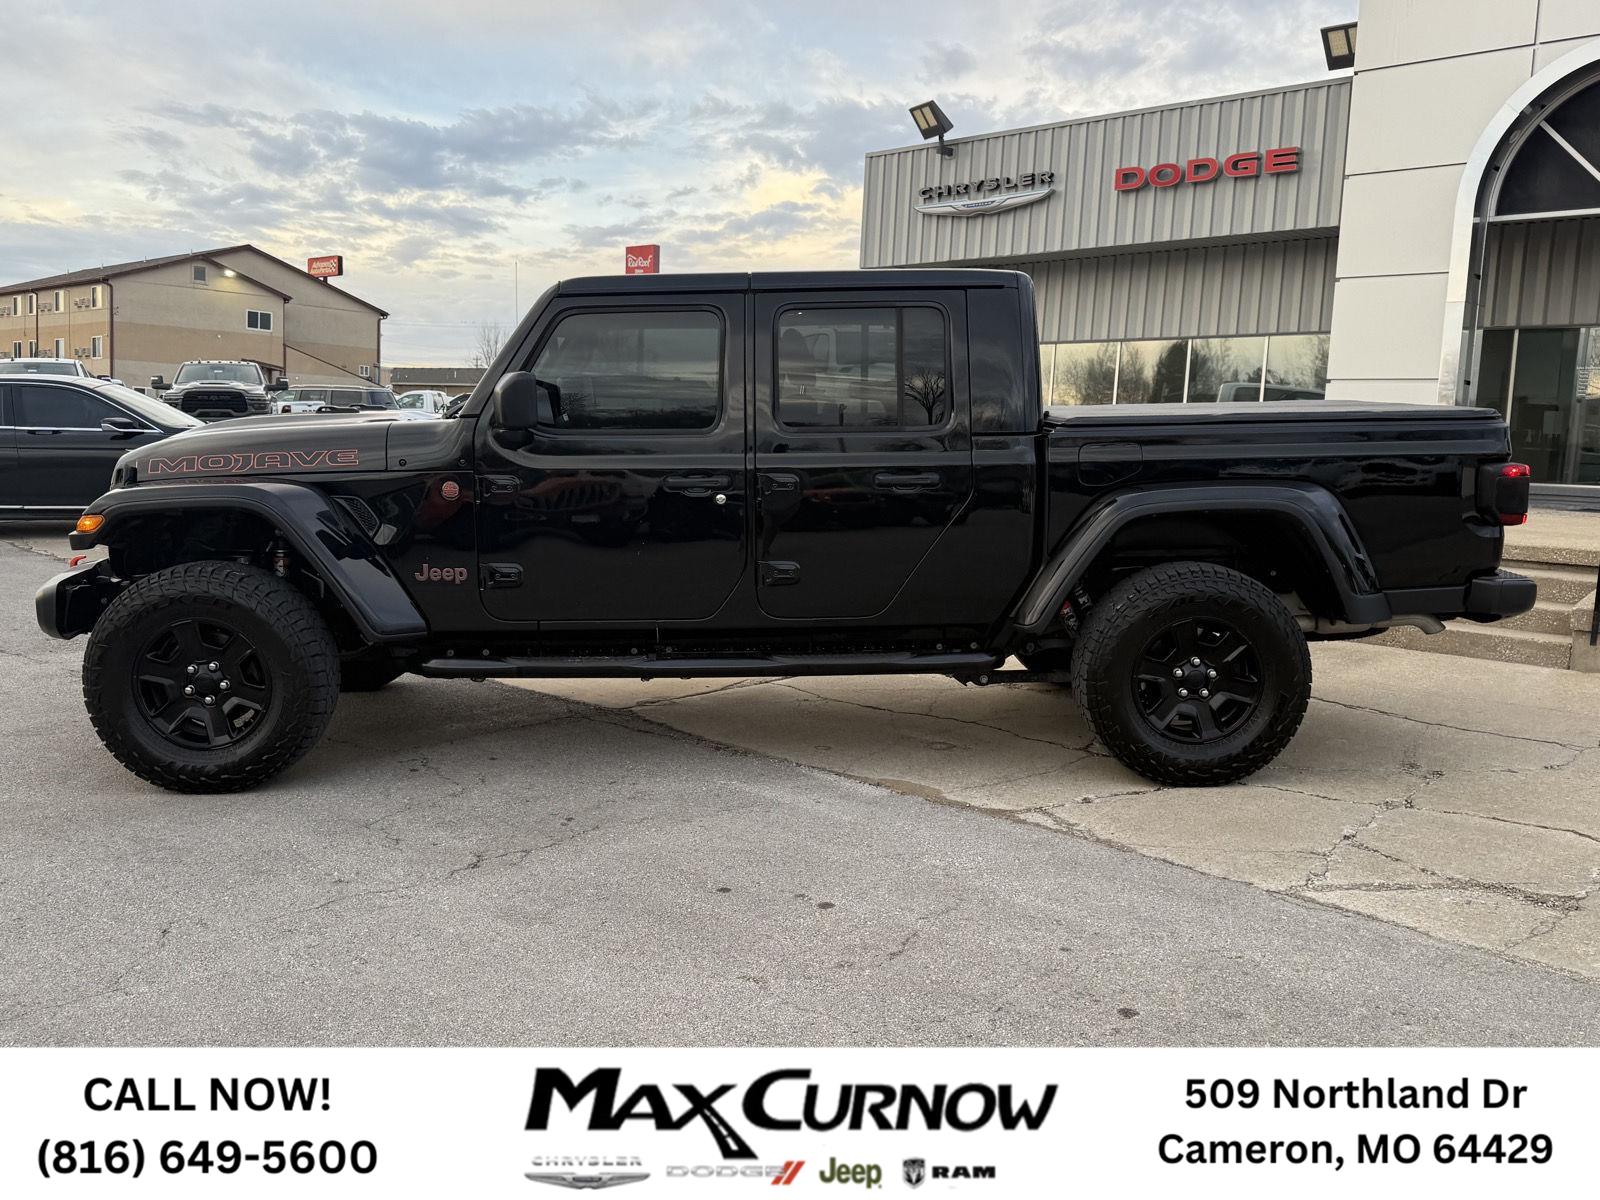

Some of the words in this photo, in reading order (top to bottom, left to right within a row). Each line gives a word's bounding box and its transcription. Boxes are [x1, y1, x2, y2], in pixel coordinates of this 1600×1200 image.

[1114, 147, 1301, 192] DODGE
[918, 172, 1055, 199] CHRYSLER
[148, 449, 359, 474] MOJAVE
[414, 563, 468, 585] Jeep
